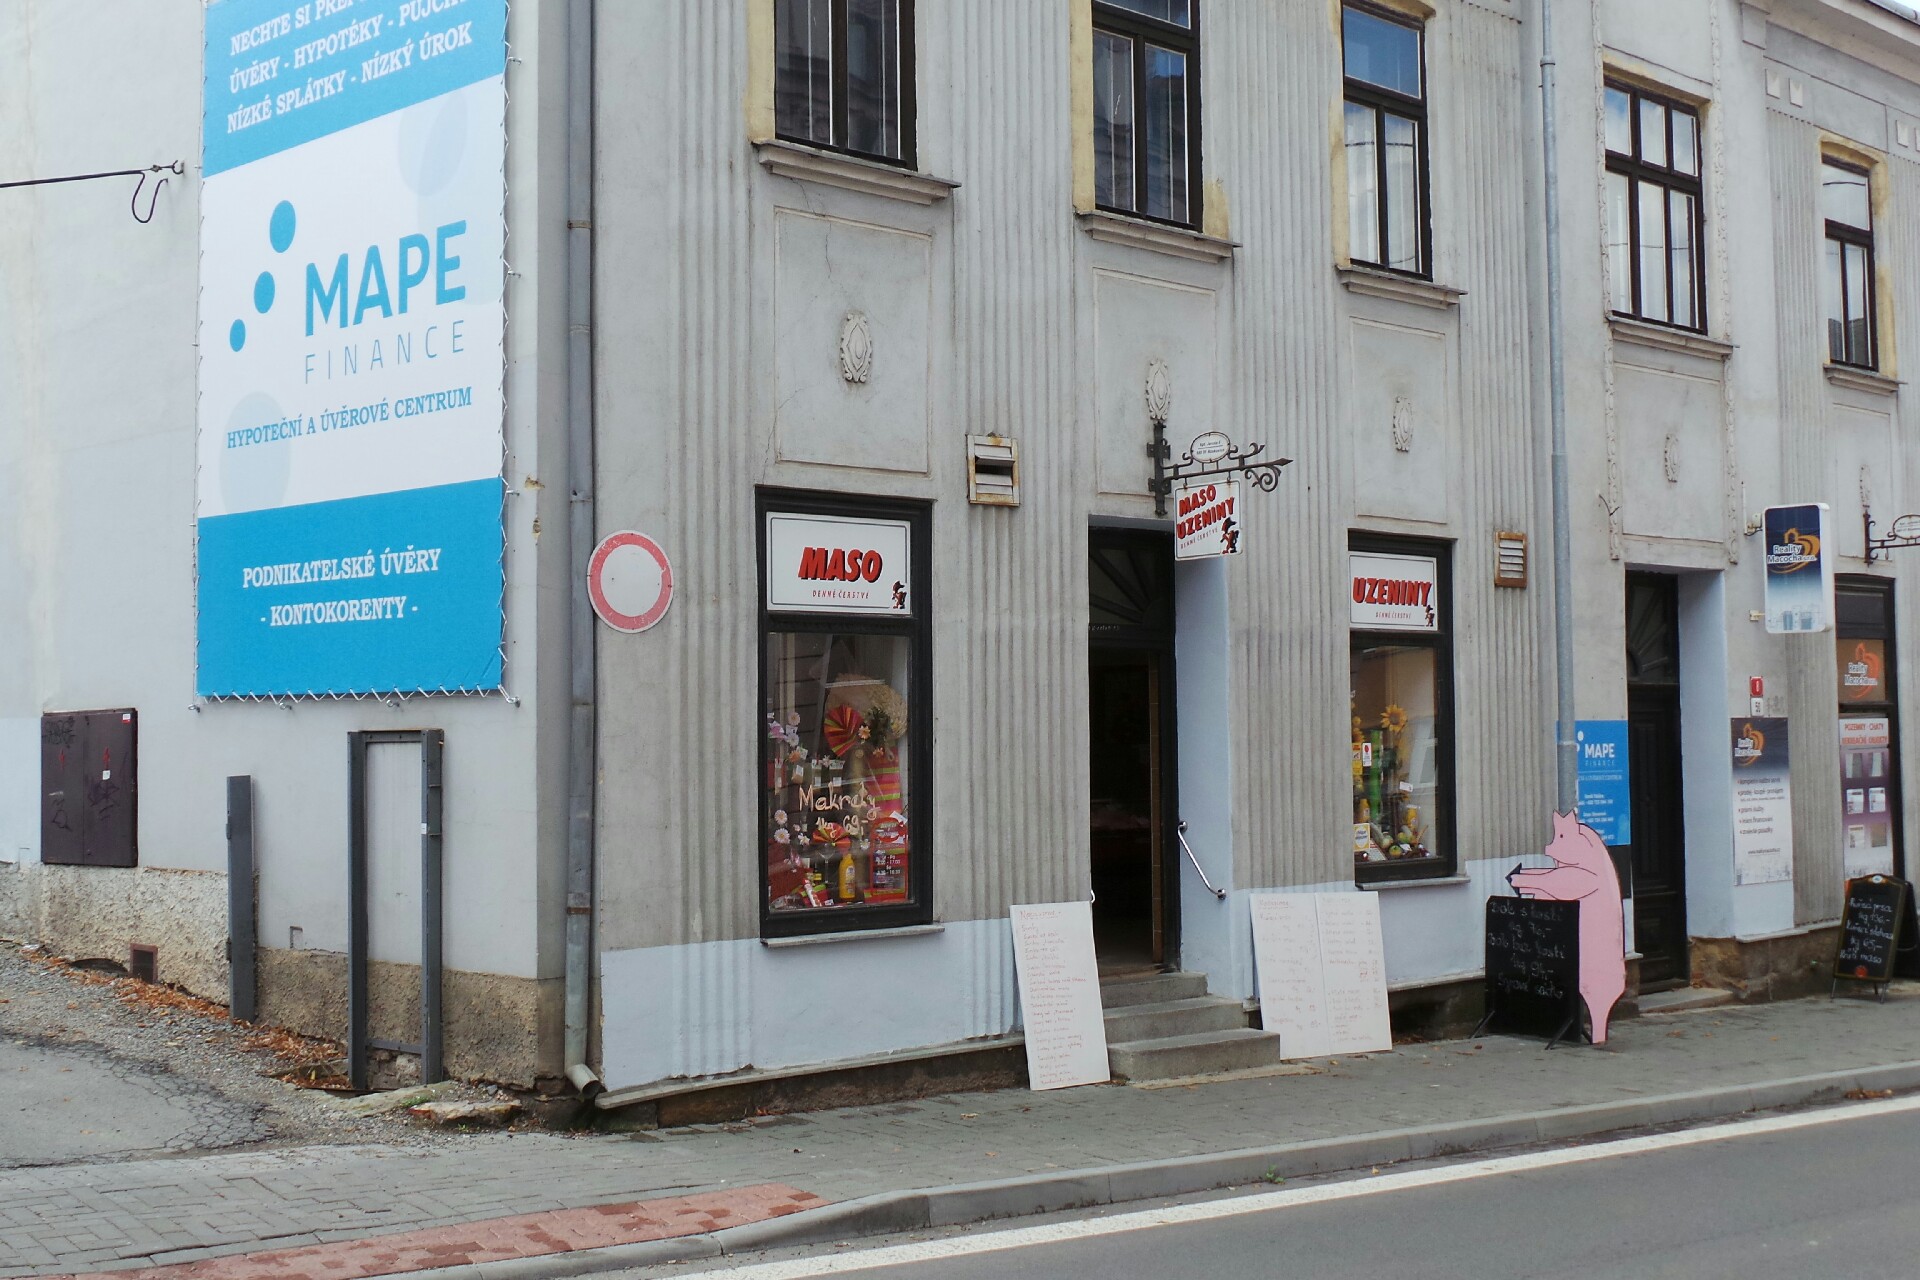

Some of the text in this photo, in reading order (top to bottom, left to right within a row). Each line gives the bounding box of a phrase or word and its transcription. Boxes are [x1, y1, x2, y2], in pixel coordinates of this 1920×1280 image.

[230, 13, 291, 56] NECHTE
[295, 3, 311, 29] SI
[229, 56, 281, 94] ÚVĚRY
[293, 13, 384, 69] HYPOTÉKY
[226, 93, 273, 134] NÍZKÉ
[276, 69, 347, 115] SPLÁTKY
[361, 37, 416, 84] NÍZKÝ
[419, 20, 473, 61] ÚROK
[305, 219, 467, 337] MAPE
[305, 319, 465, 385] FINANCE
[227, 386, 473, 449] HYPOTEČNÍ A ÚVĚROVÉ CENTRUM
[1176, 496, 1235, 539] UZENINY
[1179, 484, 1216, 517] MASO
[242, 545, 441, 588] PODNIKATELSKÉ ÚVĚRY
[798, 547, 883, 583] MASO
[1767, 553, 1802, 563] Macocha
[1773, 544, 1802, 554] Reality
[270, 596, 407, 626] KONTOKORENTY
[1353, 577, 1432, 607] UZENINY
[1584, 743, 1616, 759] MAPE
[799, 781, 882, 821] Makrely
